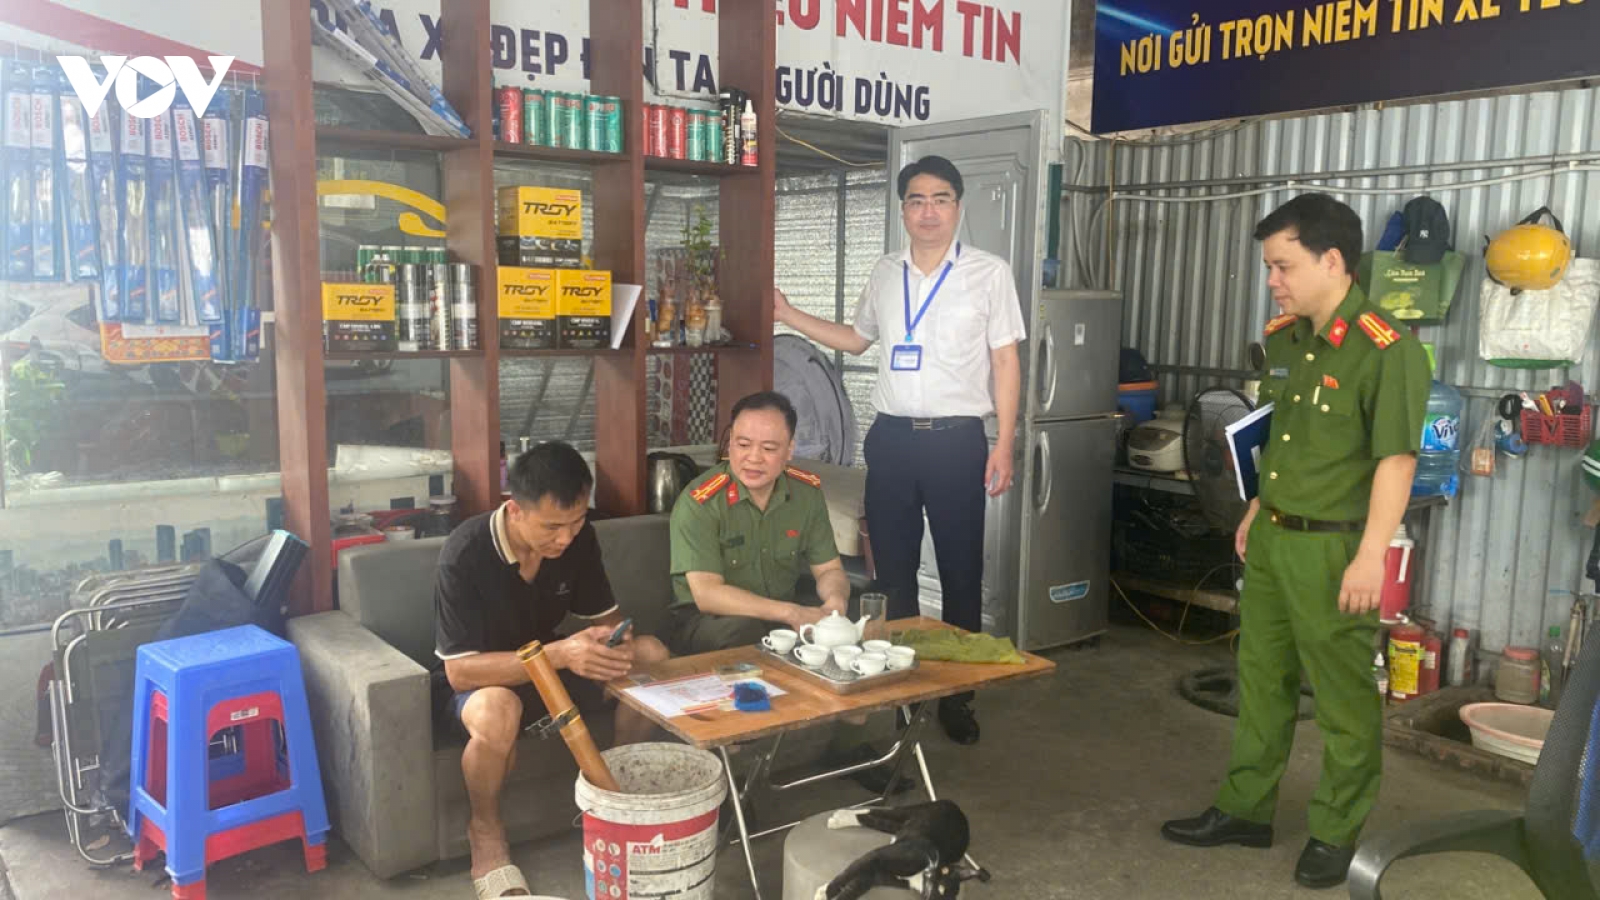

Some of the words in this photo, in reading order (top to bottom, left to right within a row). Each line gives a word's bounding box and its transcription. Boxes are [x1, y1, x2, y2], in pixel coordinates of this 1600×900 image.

[956, 0, 1021, 66] TIN
[1119, 32, 1162, 76] NƠI
[1168, 12, 1211, 68] GỬI
[1219, 9, 1295, 61] TRỌN
[1389, 0, 1445, 33] TIN
[490, 24, 569, 81] ĐẸP
[669, 49, 717, 95] TA
[775, 60, 844, 112] GƯỜI
[854, 71, 930, 121] DÙNG
[177, 113, 188, 142] BOSCH
[523, 201, 578, 217] TROY
[503, 284, 551, 296] TROY
[560, 285, 604, 297] TROY
[336, 295, 384, 306] TROY
[633, 844, 661, 855] ATM
